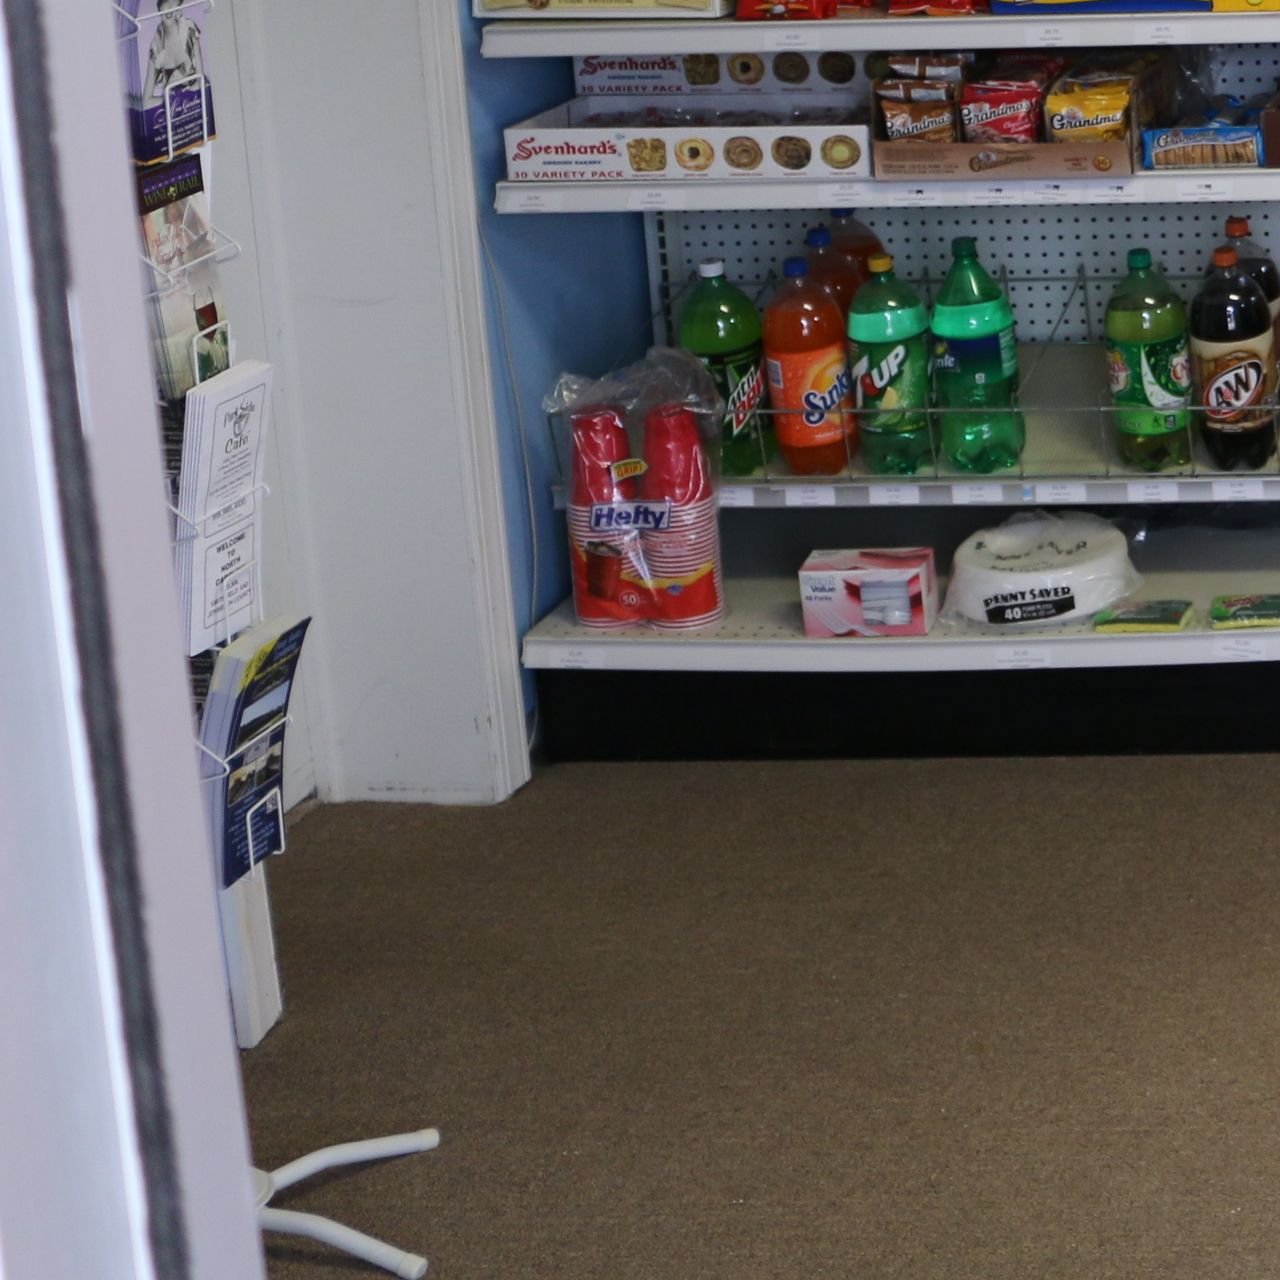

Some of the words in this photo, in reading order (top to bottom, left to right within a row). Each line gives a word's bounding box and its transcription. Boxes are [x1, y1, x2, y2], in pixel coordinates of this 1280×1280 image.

[580, 56, 677, 76] Svenhard's
[650, 85, 683, 93] PACK
[961, 101, 1031, 126] Grandma's
[512, 138, 618, 161] Svenhard's
[532, 171, 587, 179] VARIETY
[590, 170, 624, 179] PACK
[176, 175, 200, 197] TRAIL
[852, 344, 906, 410] 7UP
[1212, 369, 1250, 411] A&W
[223, 406, 239, 428] Park
[239, 397, 256, 413] Side
[594, 505, 666, 529] Hefty
[216, 531, 246, 554] WELCOME
[227, 548, 236, 558] TO
[220, 556, 241, 573] NORTH
[622, 594, 637, 604] 50
[810, 584, 836, 593] Value
[983, 590, 1028, 609] PENNY
[1029, 585, 1072, 600] SAVER
[1004, 607, 1023, 620] 40
